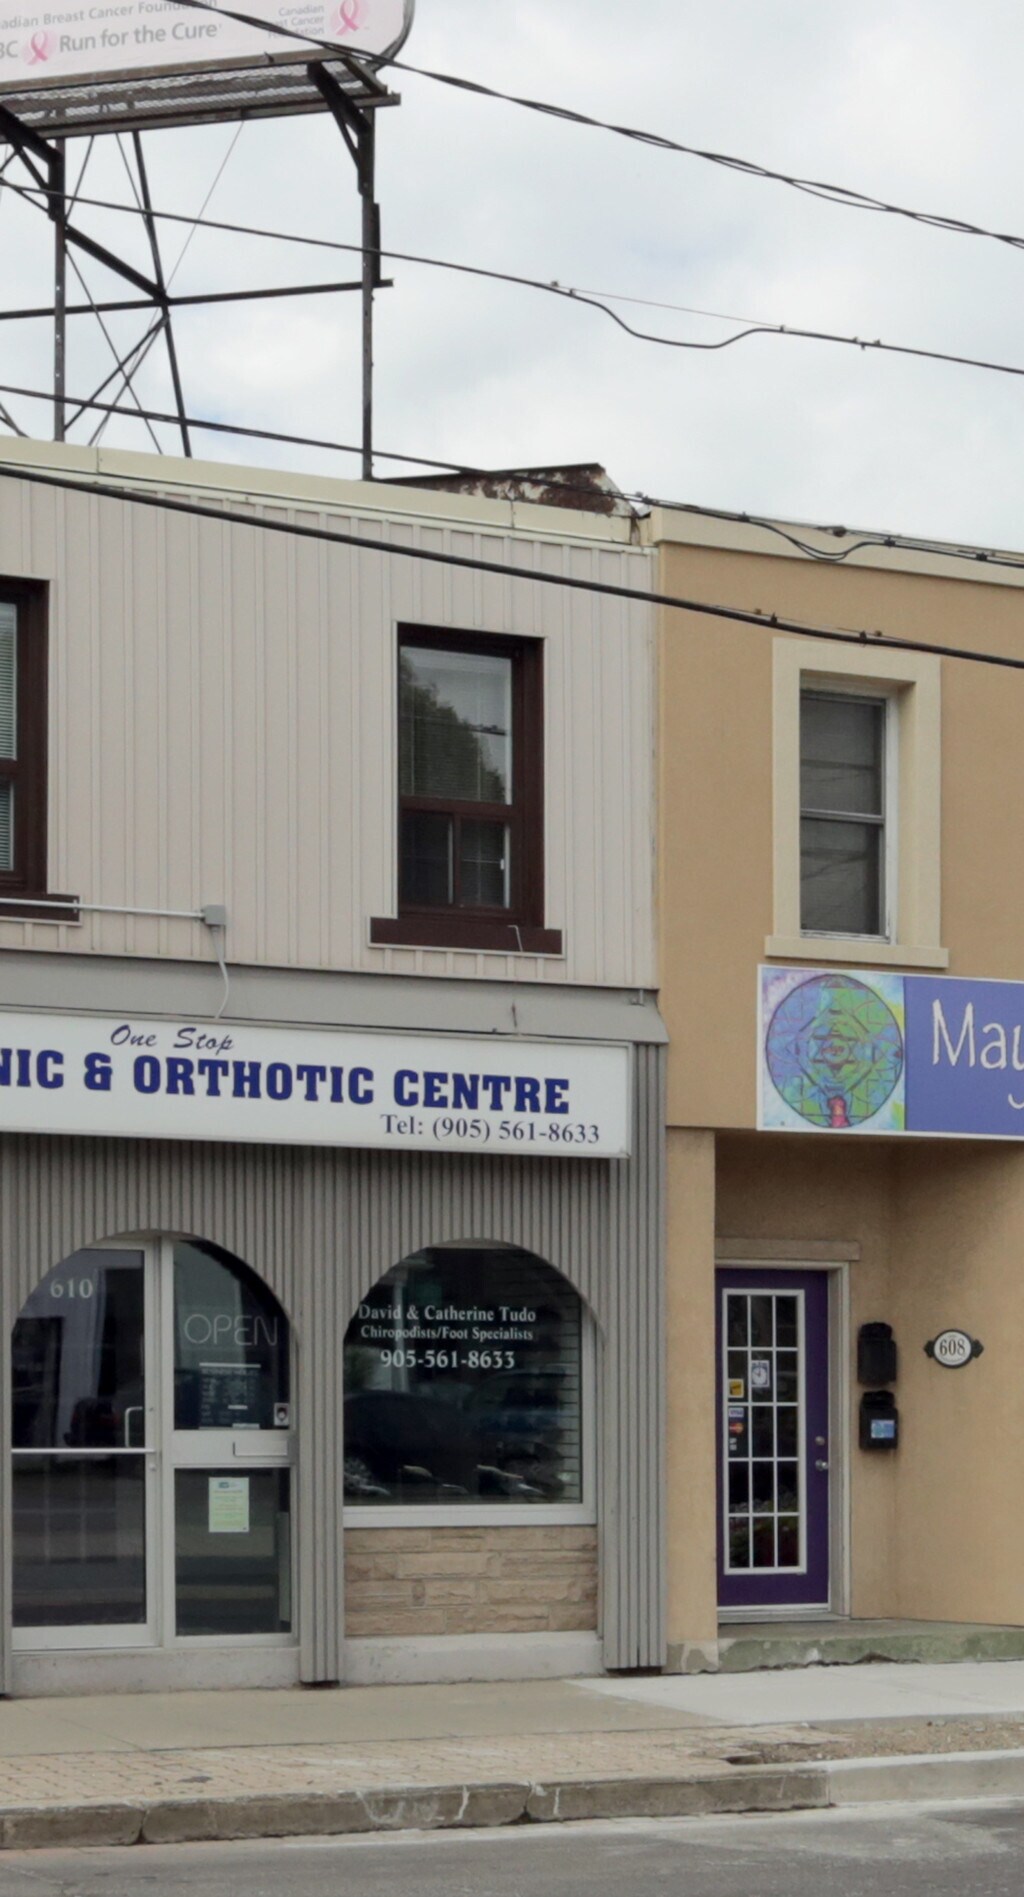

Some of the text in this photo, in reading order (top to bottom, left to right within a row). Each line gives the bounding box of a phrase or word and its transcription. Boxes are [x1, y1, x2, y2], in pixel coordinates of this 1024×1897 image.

[43, 10, 85, 25] Breast
[89, 4, 133, 20] Cancer
[279, 4, 324, 16] Canadian
[60, 35, 96, 53] Run
[101, 29, 129, 47] for
[134, 25, 166, 44] the
[172, 22, 217, 40] Cure
[110, 1024, 235, 1055] One Stop
[84, 1052, 112, 1091] &
[133, 1055, 375, 1104] ORTHOTIC
[393, 1069, 570, 1114] CENTRE
[380, 1114, 600, 1144] Tel: (905) 561-8633
[50, 1278, 93, 1299] 610
[358, 1304, 537, 1322] David & Catherine Tudo
[184, 1313, 278, 1347] OPEN
[360, 1325, 533, 1342] Chiropodists/Foot Specialists
[940, 1338, 965, 1356] 608
[380, 1350, 515, 1369] 905-561-8633
